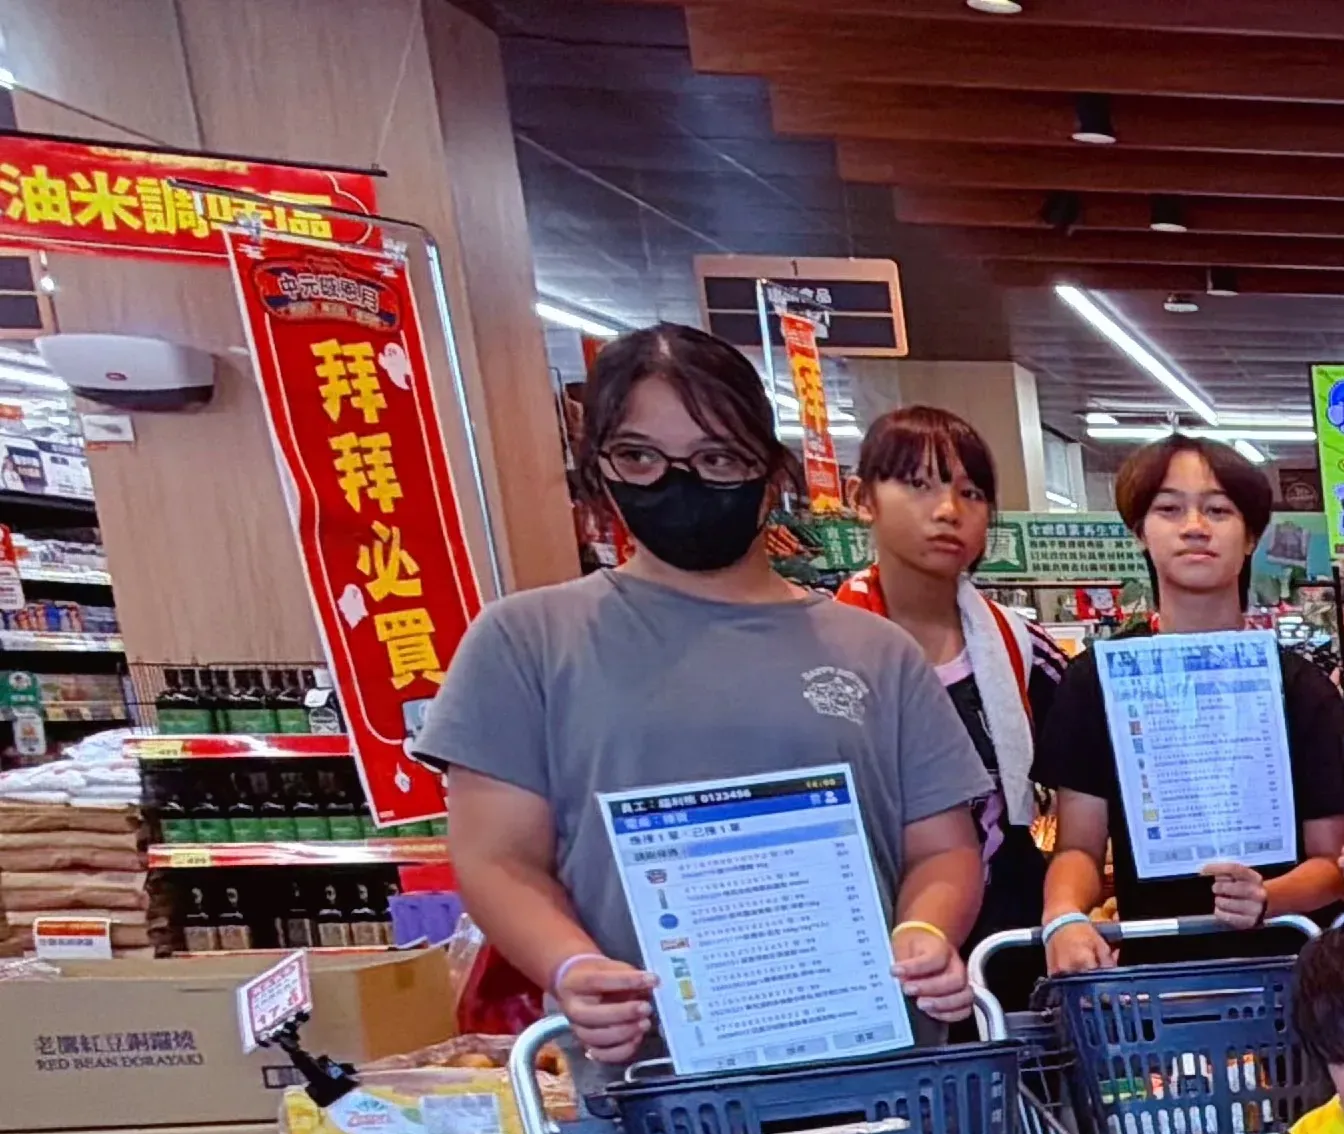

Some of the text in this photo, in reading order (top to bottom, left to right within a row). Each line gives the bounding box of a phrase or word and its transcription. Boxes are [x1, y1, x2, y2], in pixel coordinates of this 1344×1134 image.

[0, 163, 332, 242] 油米調味區
[310, 338, 447, 690] 拜拜必買
